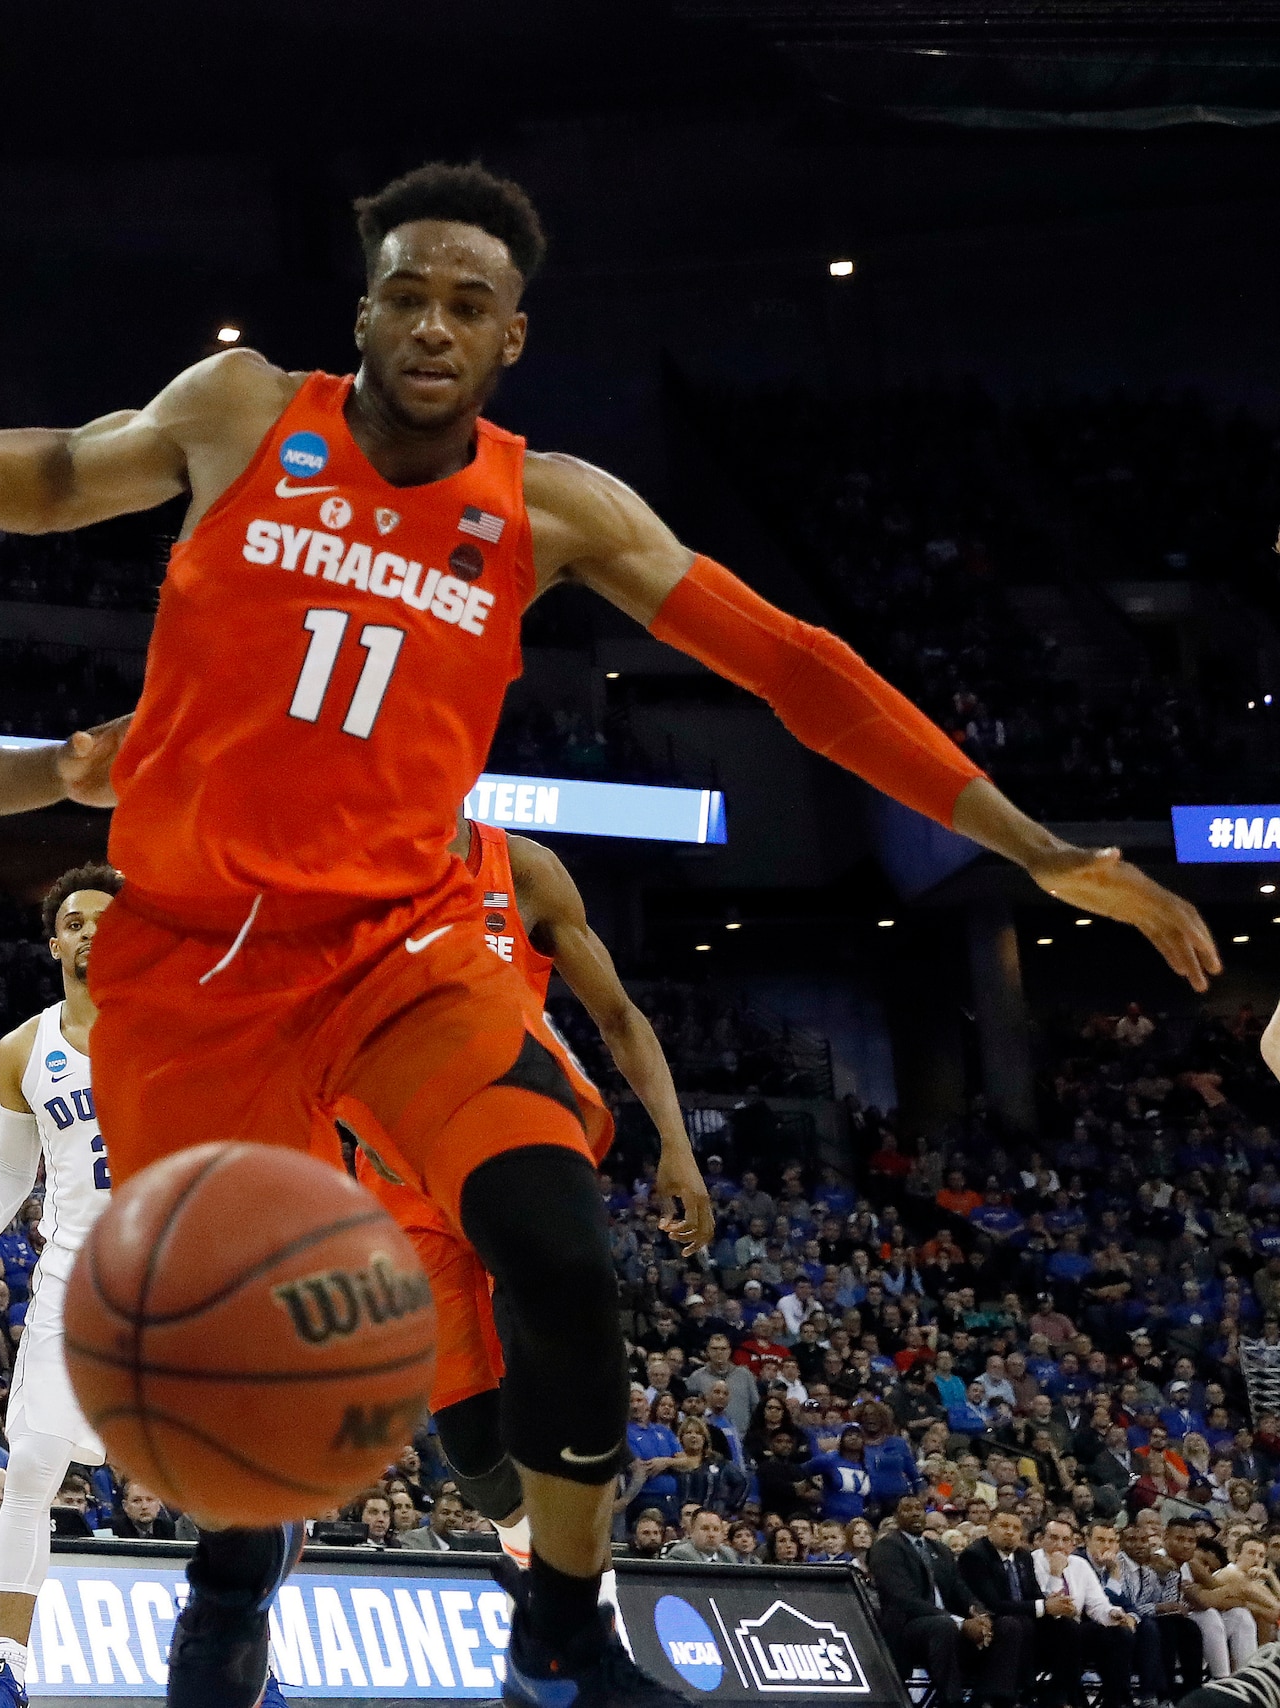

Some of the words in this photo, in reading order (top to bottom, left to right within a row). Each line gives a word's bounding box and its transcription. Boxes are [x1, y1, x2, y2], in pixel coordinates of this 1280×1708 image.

[284, 449, 324, 469] NCAA
[242, 518, 496, 637] SYRACUSE
[287, 606, 408, 740] 11
[1208, 817, 1280, 850] #MA
[48, 1058, 66, 1068] NCAA
[43, 1088, 97, 1131] DU
[268, 1585, 513, 1688] MADNES
[668, 1641, 723, 1666] NCAA
[749, 1636, 852, 1682] LOWE'S
